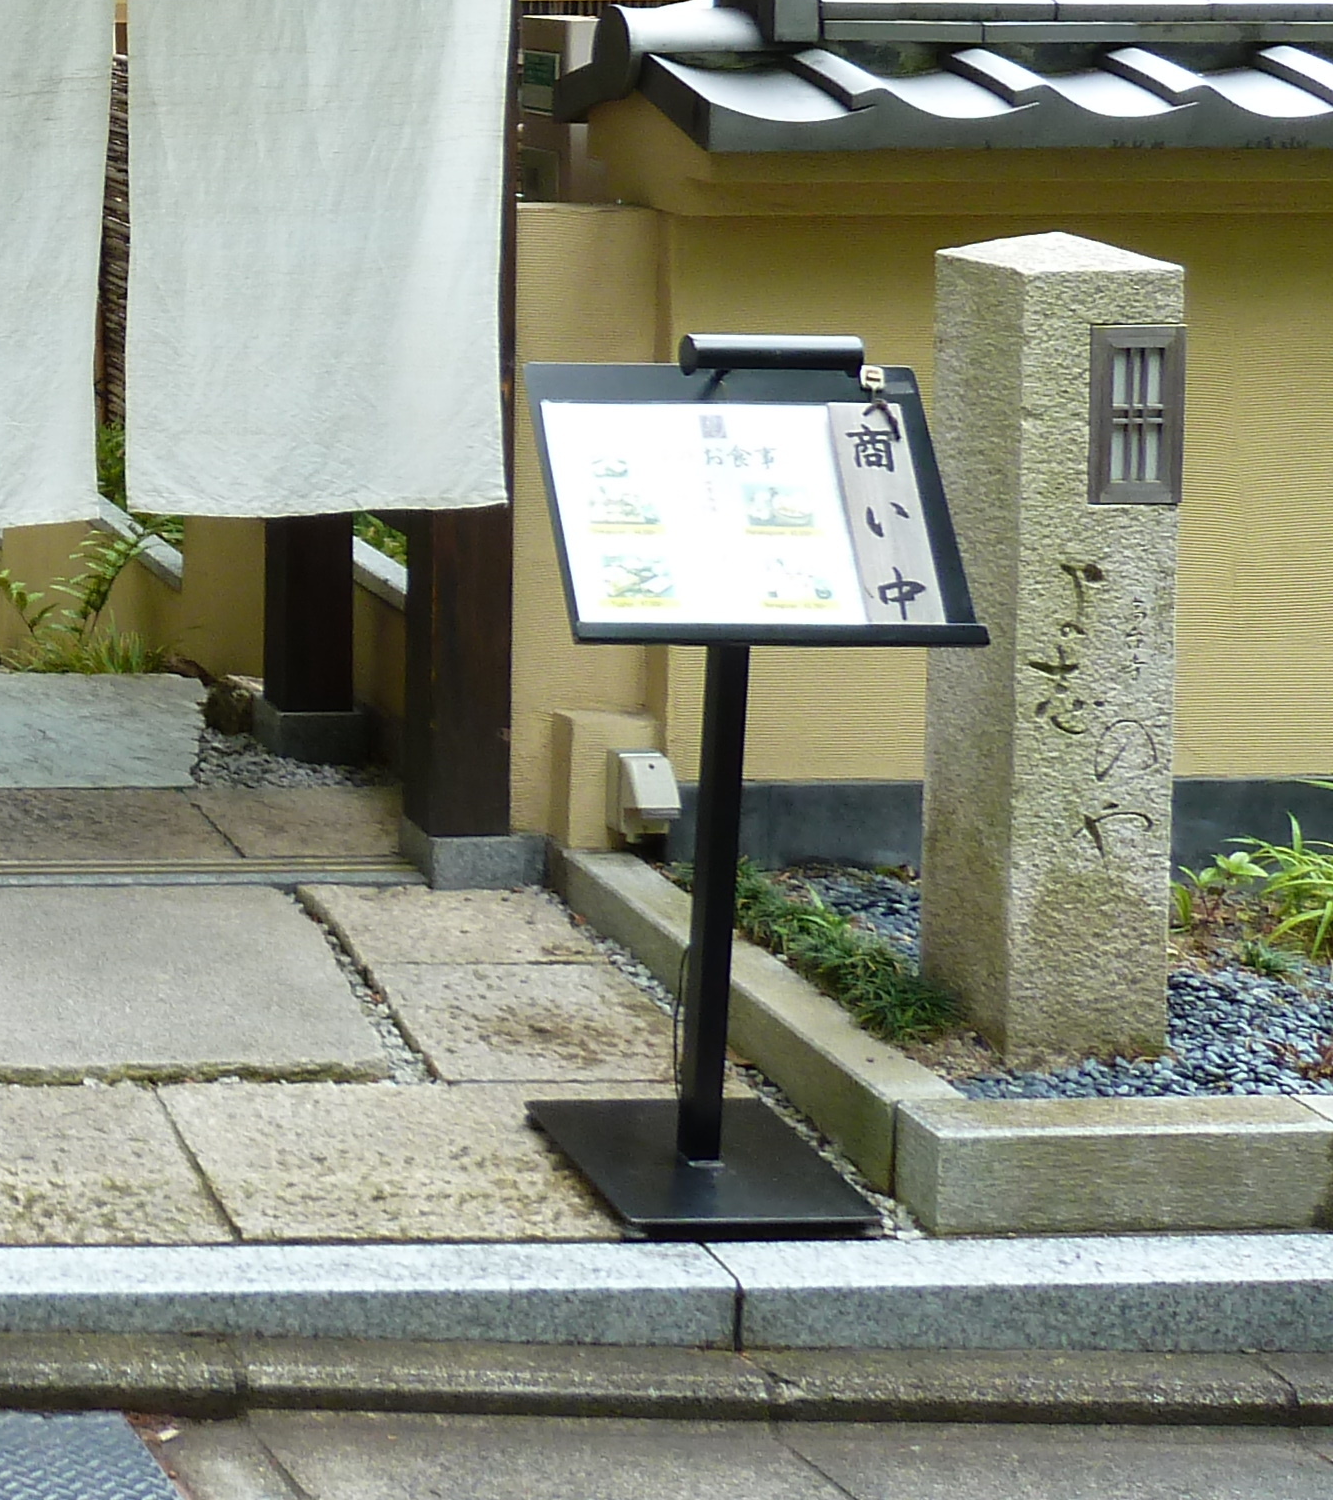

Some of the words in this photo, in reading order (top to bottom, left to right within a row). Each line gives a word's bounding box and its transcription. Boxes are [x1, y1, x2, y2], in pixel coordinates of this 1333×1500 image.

[705, 445, 776, 470] お食事
[846, 425, 926, 620] 商い中
